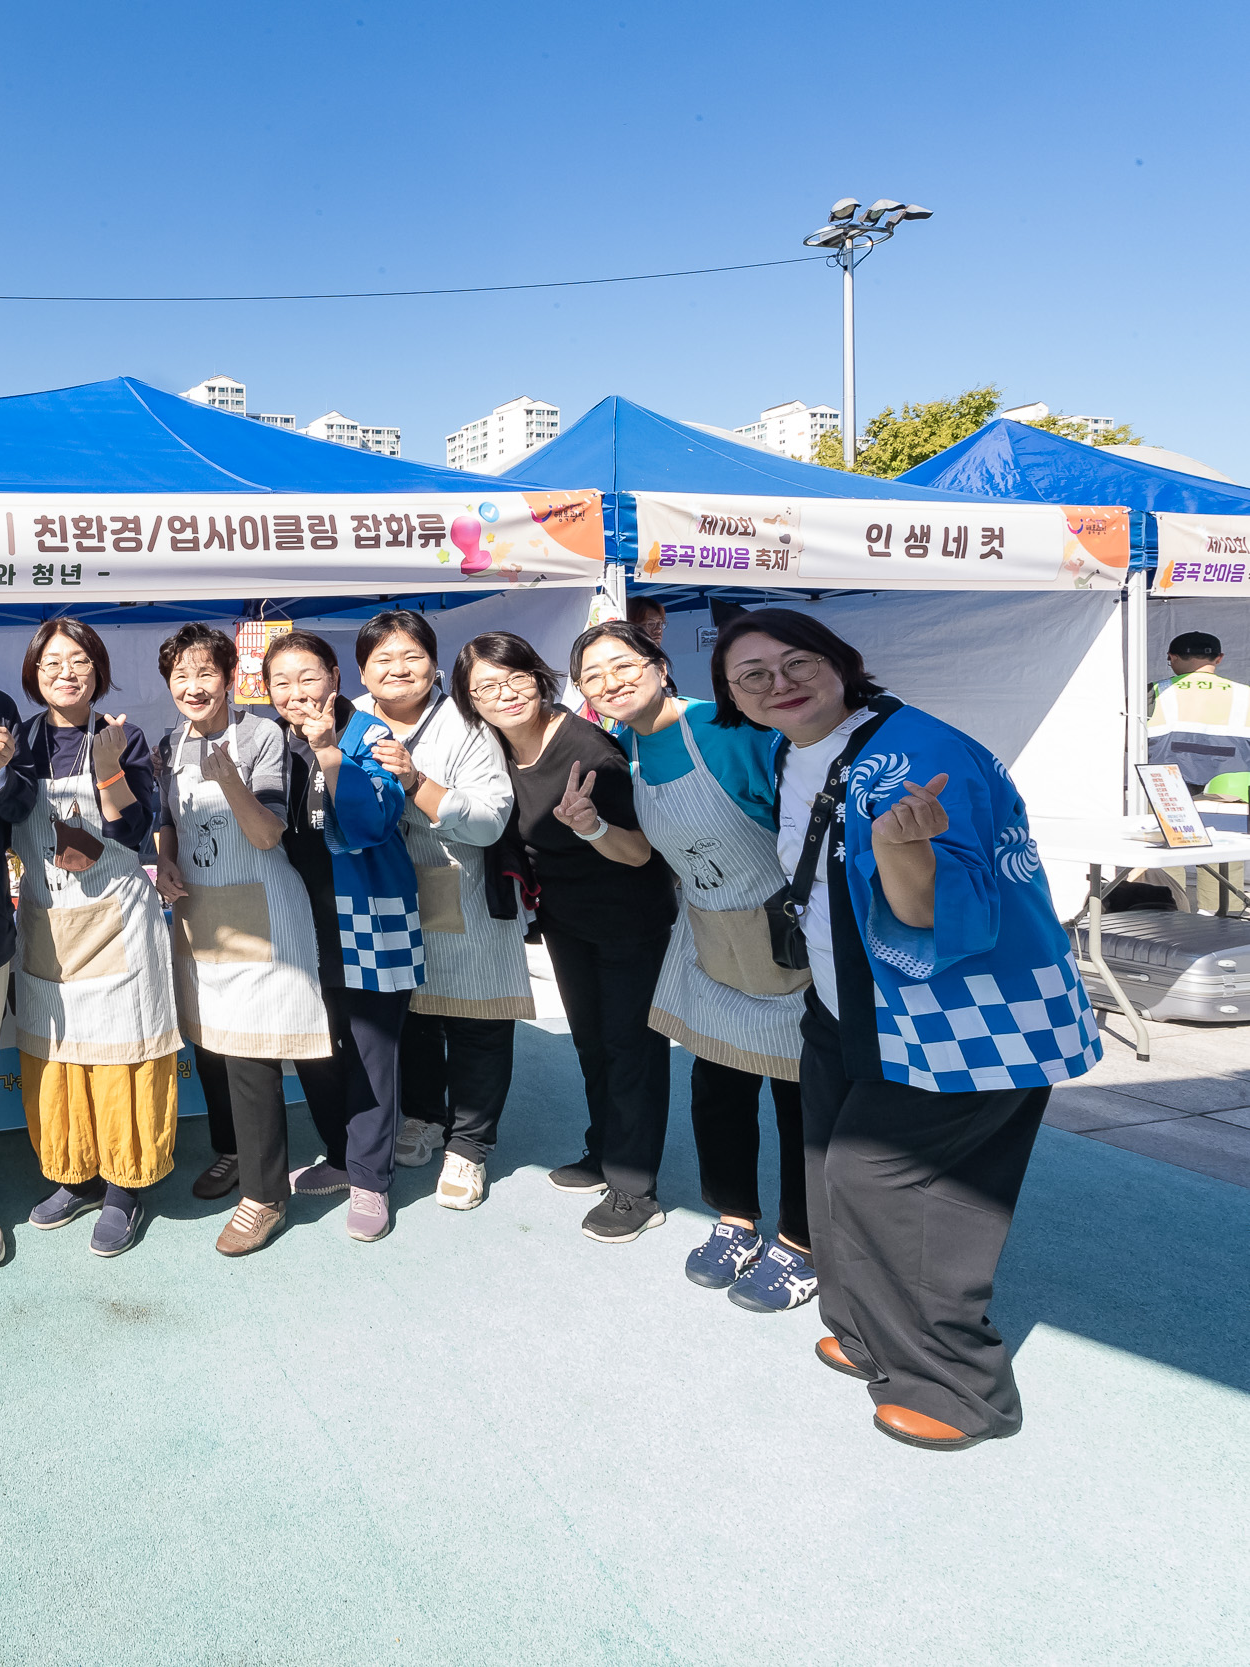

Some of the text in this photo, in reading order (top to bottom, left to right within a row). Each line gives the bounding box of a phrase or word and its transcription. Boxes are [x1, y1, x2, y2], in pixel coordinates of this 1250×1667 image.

[34, 513, 338, 552] 친환경/업사이클링
[351, 513, 447, 550] 잡화류
[698, 514, 757, 538] 제10회
[659, 544, 789, 571] 중곡 한마음 축제
[31, 563, 82, 586] 청년
[1171, 562, 1202, 583] 중곡
[1202, 562, 1246, 583] 한마음
